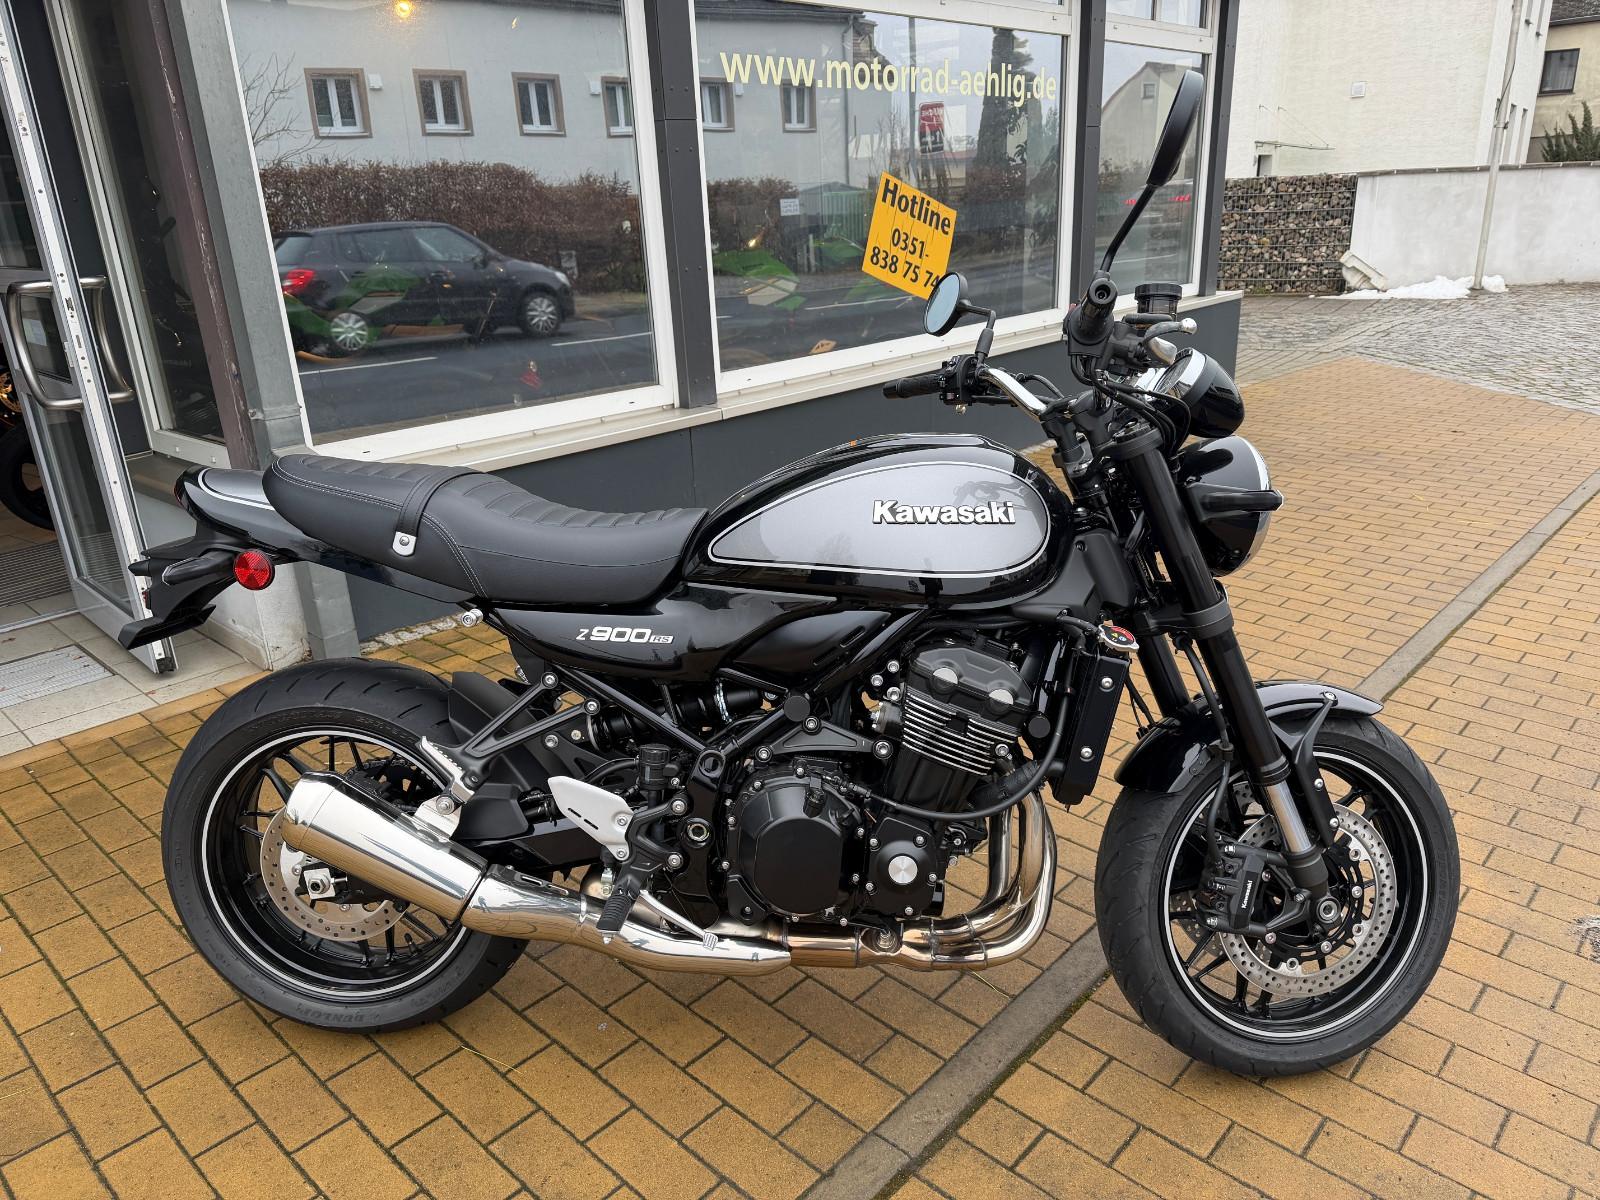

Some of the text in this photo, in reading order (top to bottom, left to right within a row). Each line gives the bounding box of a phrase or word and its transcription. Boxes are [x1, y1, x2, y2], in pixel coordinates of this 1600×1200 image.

[719, 51, 1056, 107] www.motorrad-aehlig.de
[881, 178, 951, 236] Hotline
[891, 228, 929, 259] 0351-
[870, 246, 899, 274] 838
[902, 260, 920, 283] 75
[872, 499, 1016, 525] Kawasaki
[1241, 880, 1253, 909] Kawasaki
